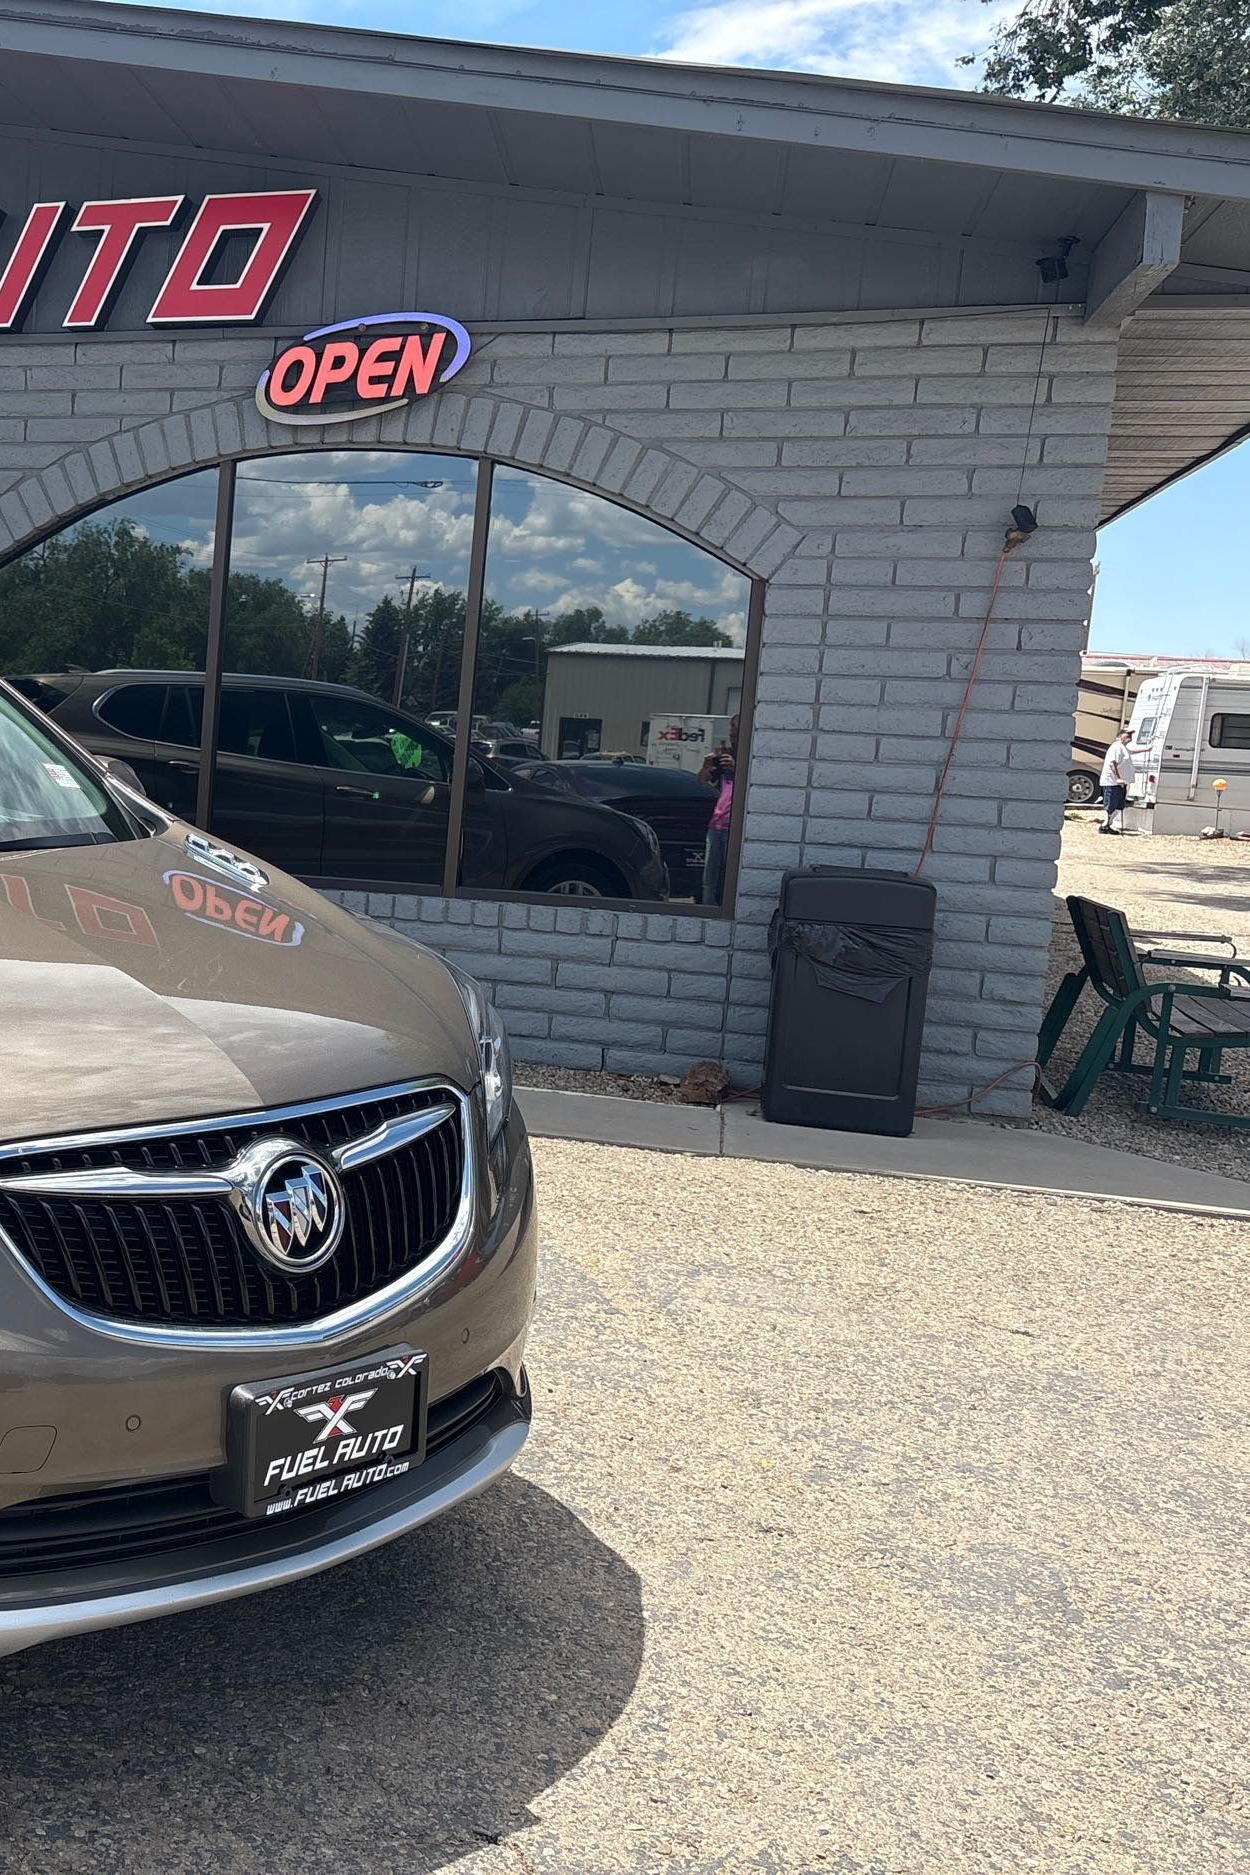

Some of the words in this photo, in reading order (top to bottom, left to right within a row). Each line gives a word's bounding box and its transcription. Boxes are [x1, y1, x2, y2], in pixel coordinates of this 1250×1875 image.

[268, 331, 448, 408] OPEN
[263, 1445, 330, 1487] FUEL
[333, 1424, 404, 1464] AUTO
